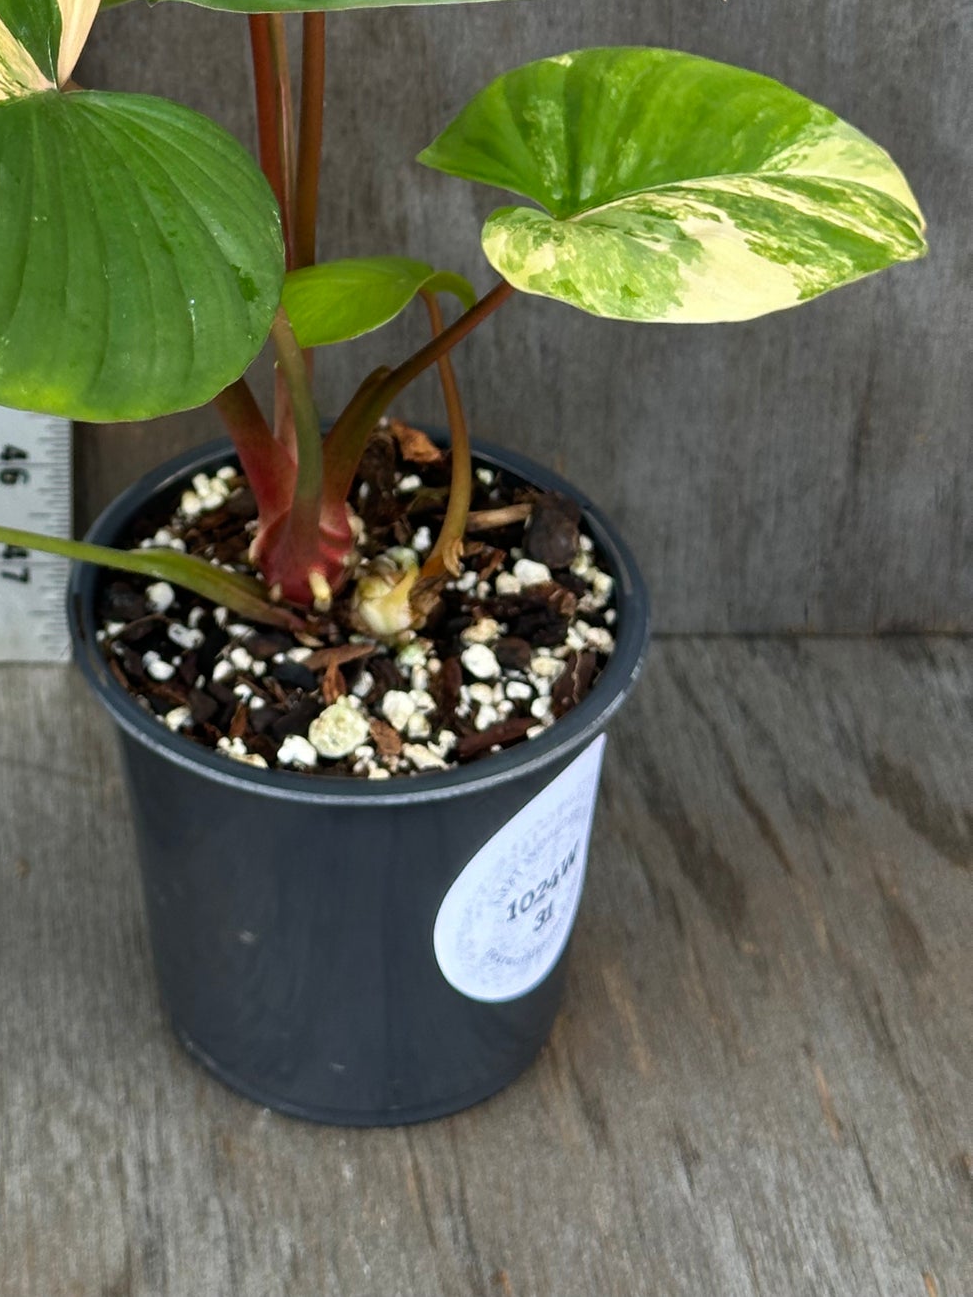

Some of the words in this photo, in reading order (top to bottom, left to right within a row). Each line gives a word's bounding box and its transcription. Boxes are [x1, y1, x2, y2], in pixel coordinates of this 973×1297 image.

[0, 544, 31, 584] 47
[506, 838, 581, 922] 1024W
[533, 901, 554, 932] 31
